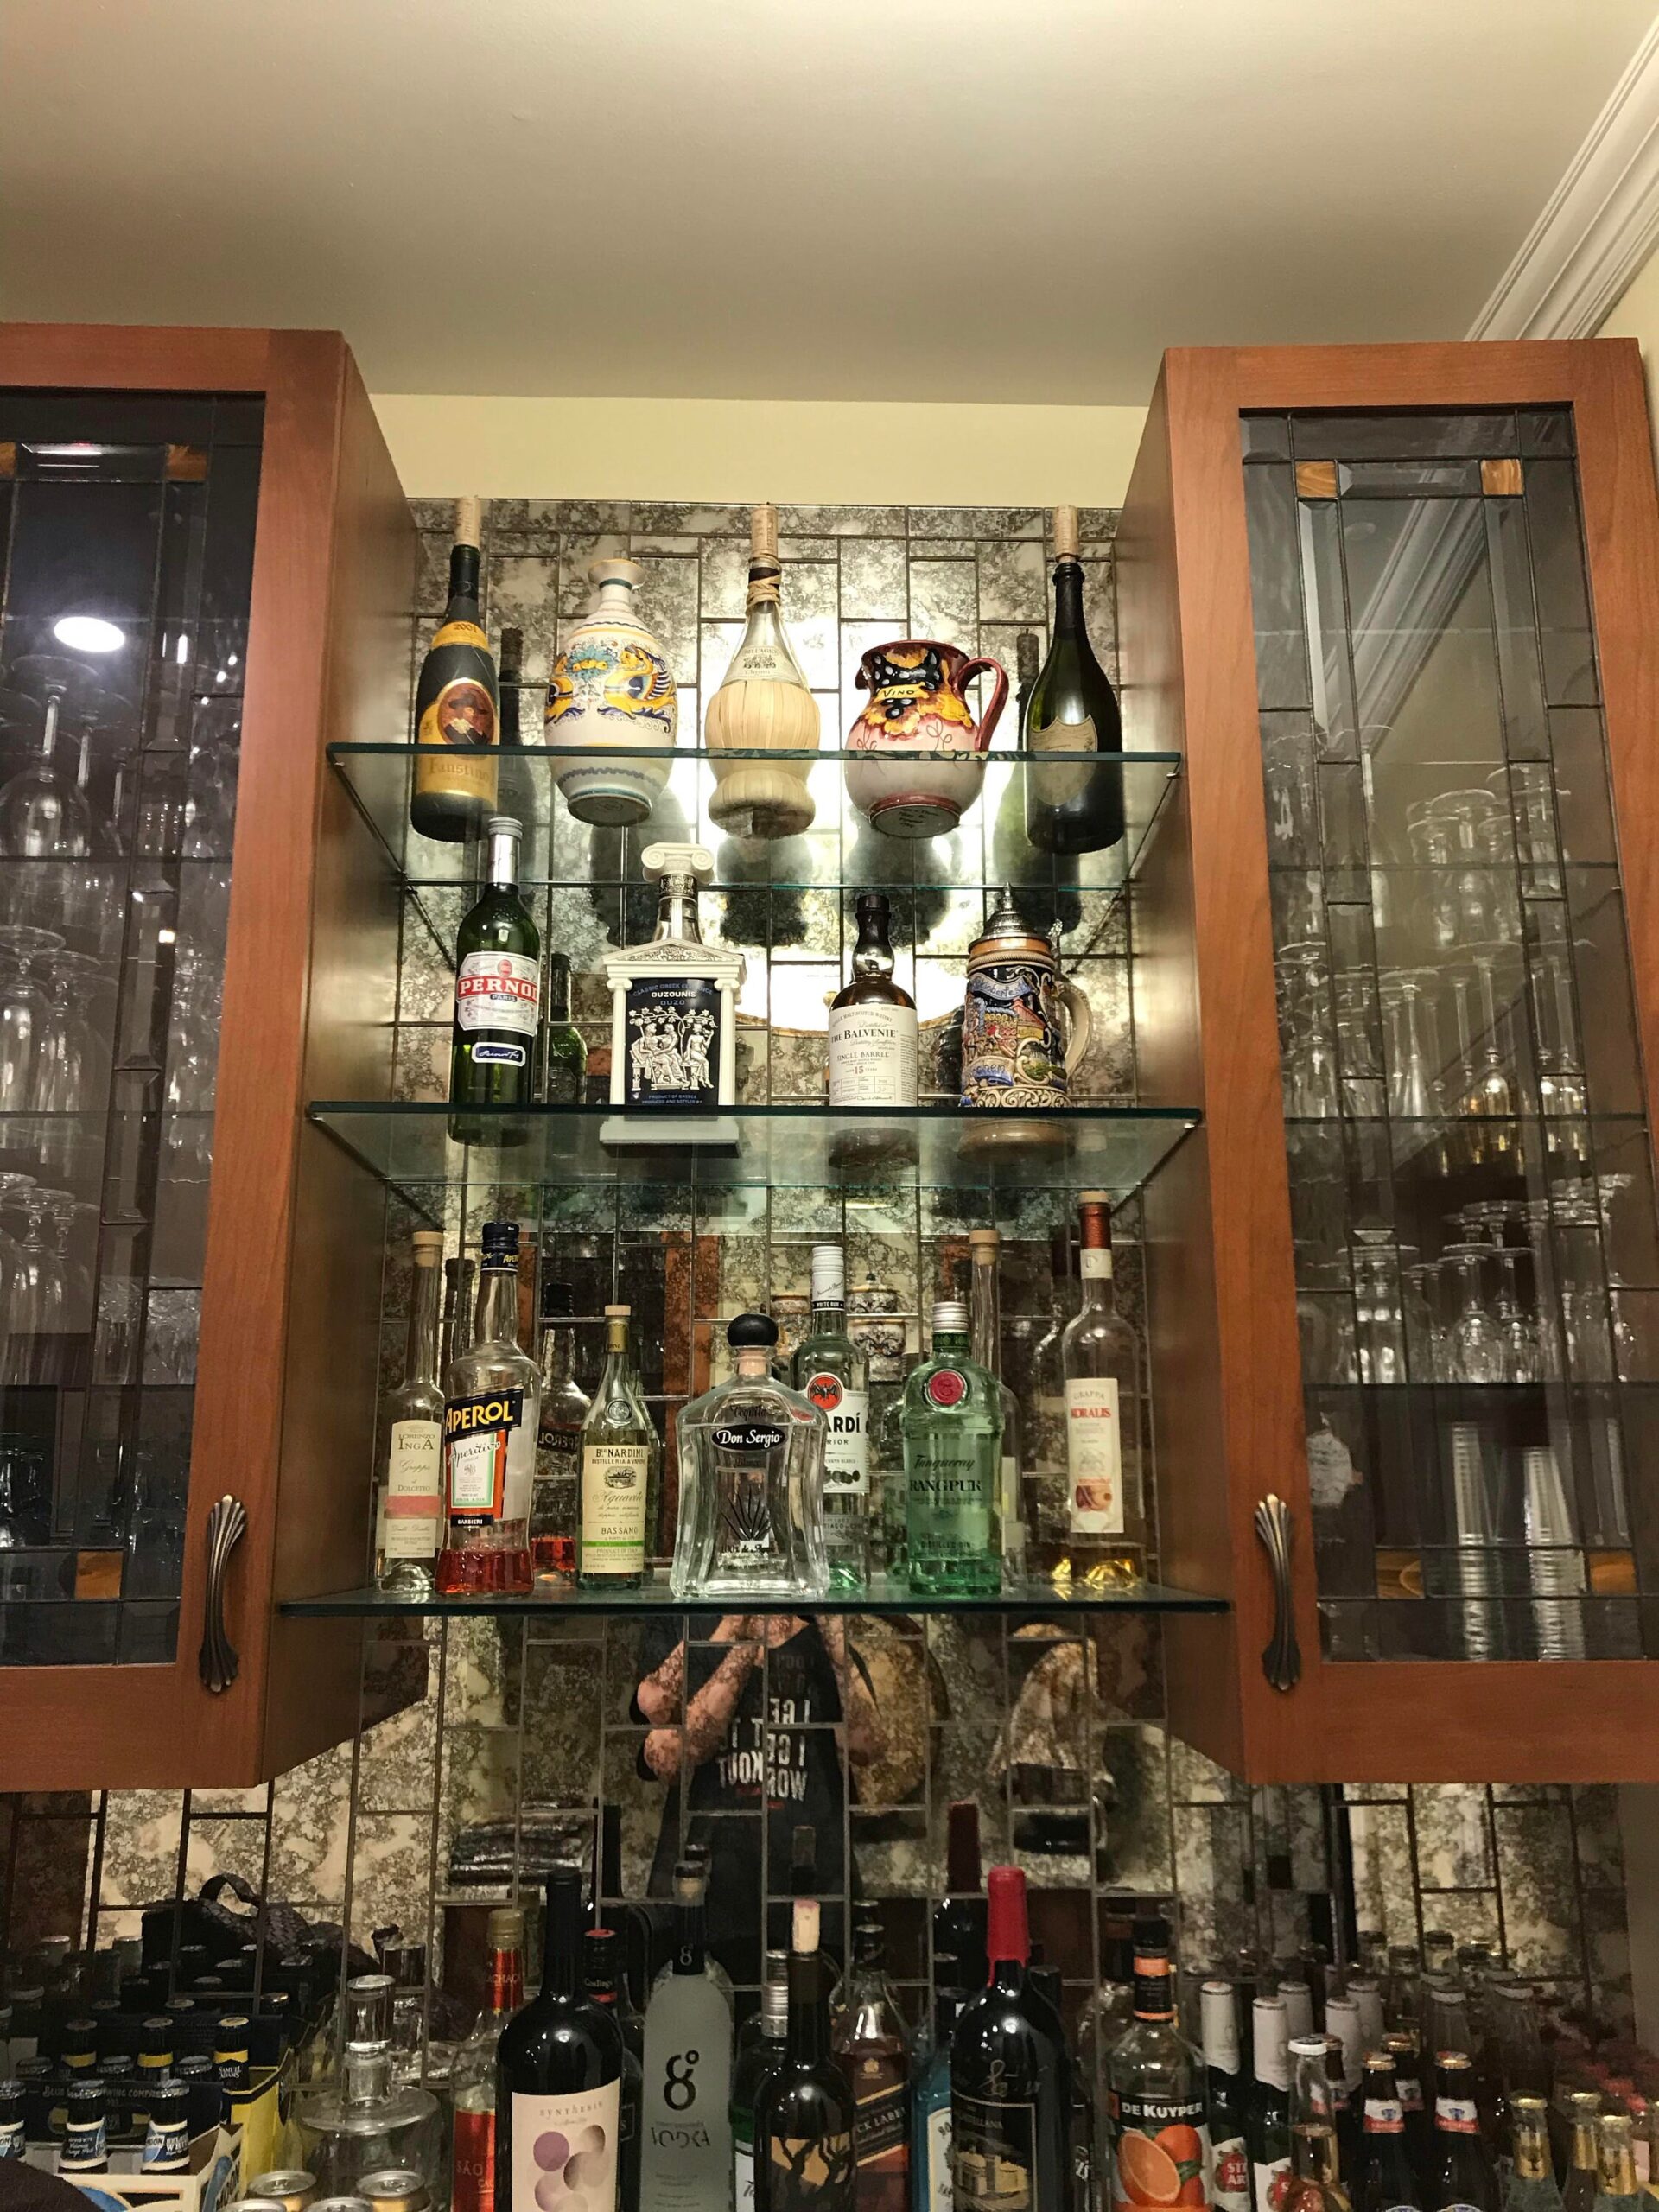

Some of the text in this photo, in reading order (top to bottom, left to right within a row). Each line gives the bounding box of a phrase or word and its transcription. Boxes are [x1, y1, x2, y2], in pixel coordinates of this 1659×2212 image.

[883, 688, 916, 697] VINO
[831, 1028, 896, 1044] THE BALVENIE
[854, 1066, 864, 1075] 15
[446, 1400, 513, 1433] APEROL
[716, 1428, 781, 1449] Don Sergio
[448, 1440, 501, 1467] Aperitivo
[607, 1447, 644, 1459] NARDINI
[913, 1454, 976, 1471] Tanqueray
[910, 1478, 982, 1492] RANGPUR
[601, 1526, 639, 1535] BASSANO
[1122, 2101, 1203, 2118] DE KUYPER
